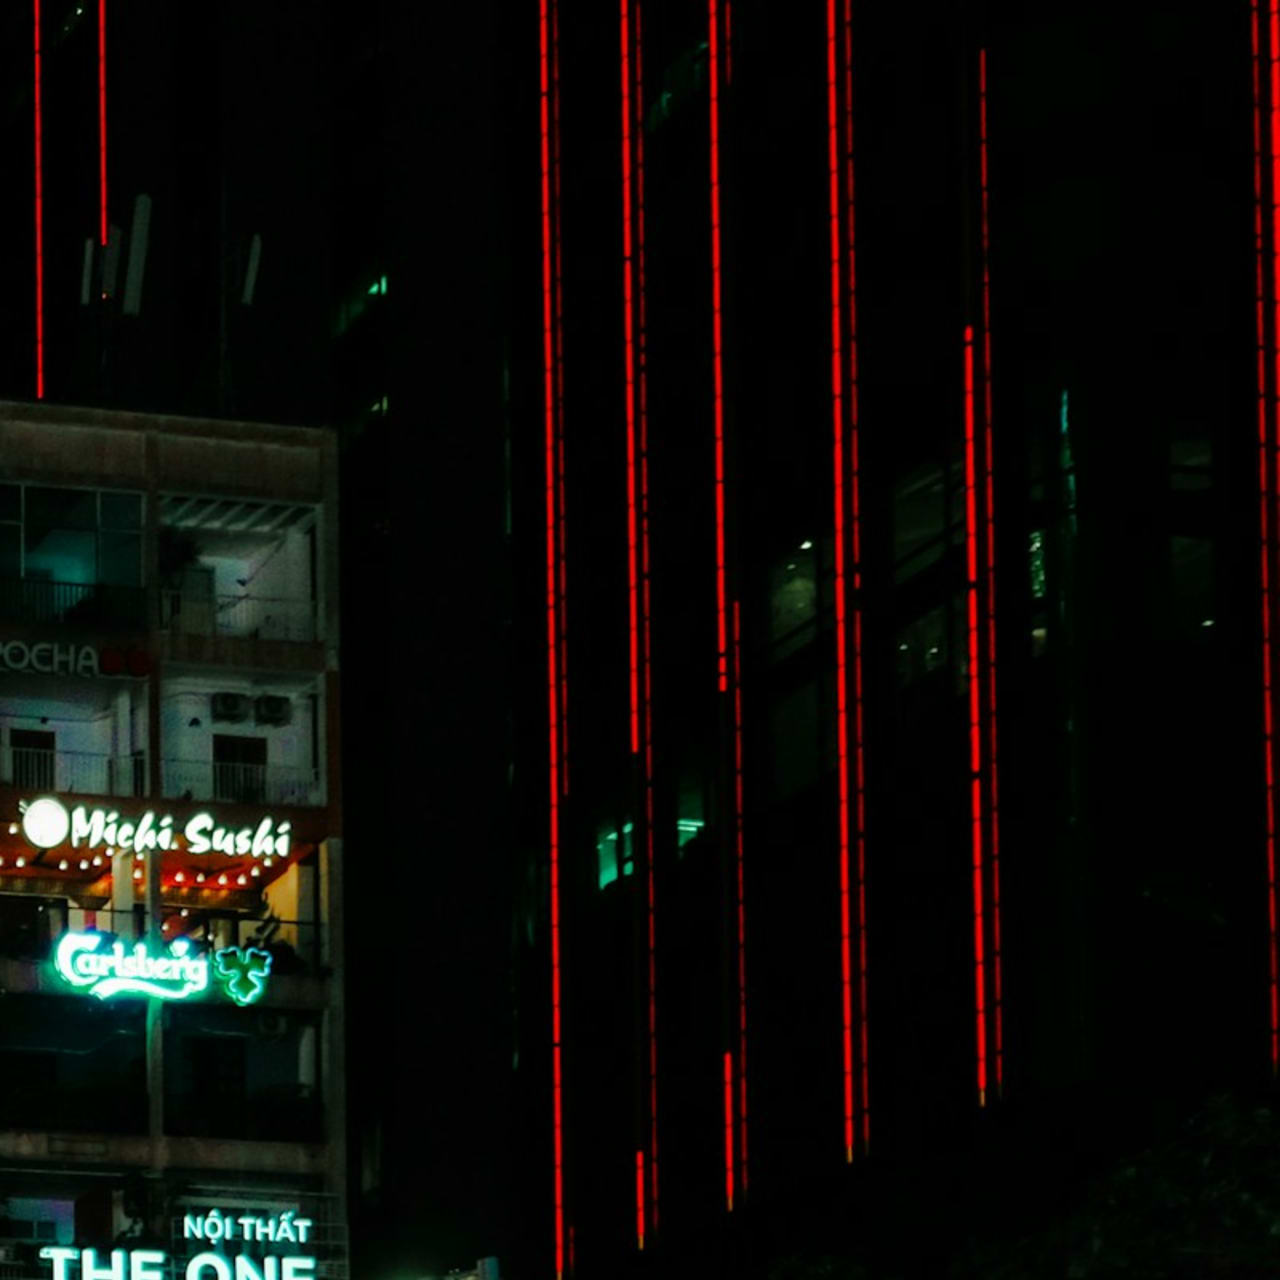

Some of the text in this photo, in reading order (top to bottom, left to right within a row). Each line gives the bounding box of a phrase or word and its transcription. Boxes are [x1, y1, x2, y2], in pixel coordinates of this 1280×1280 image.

[71, 806, 292, 857] Michi Sushi
[56, 932, 209, 993] Carlsberg
[183, 1208, 312, 1247] NỘI THẤT
